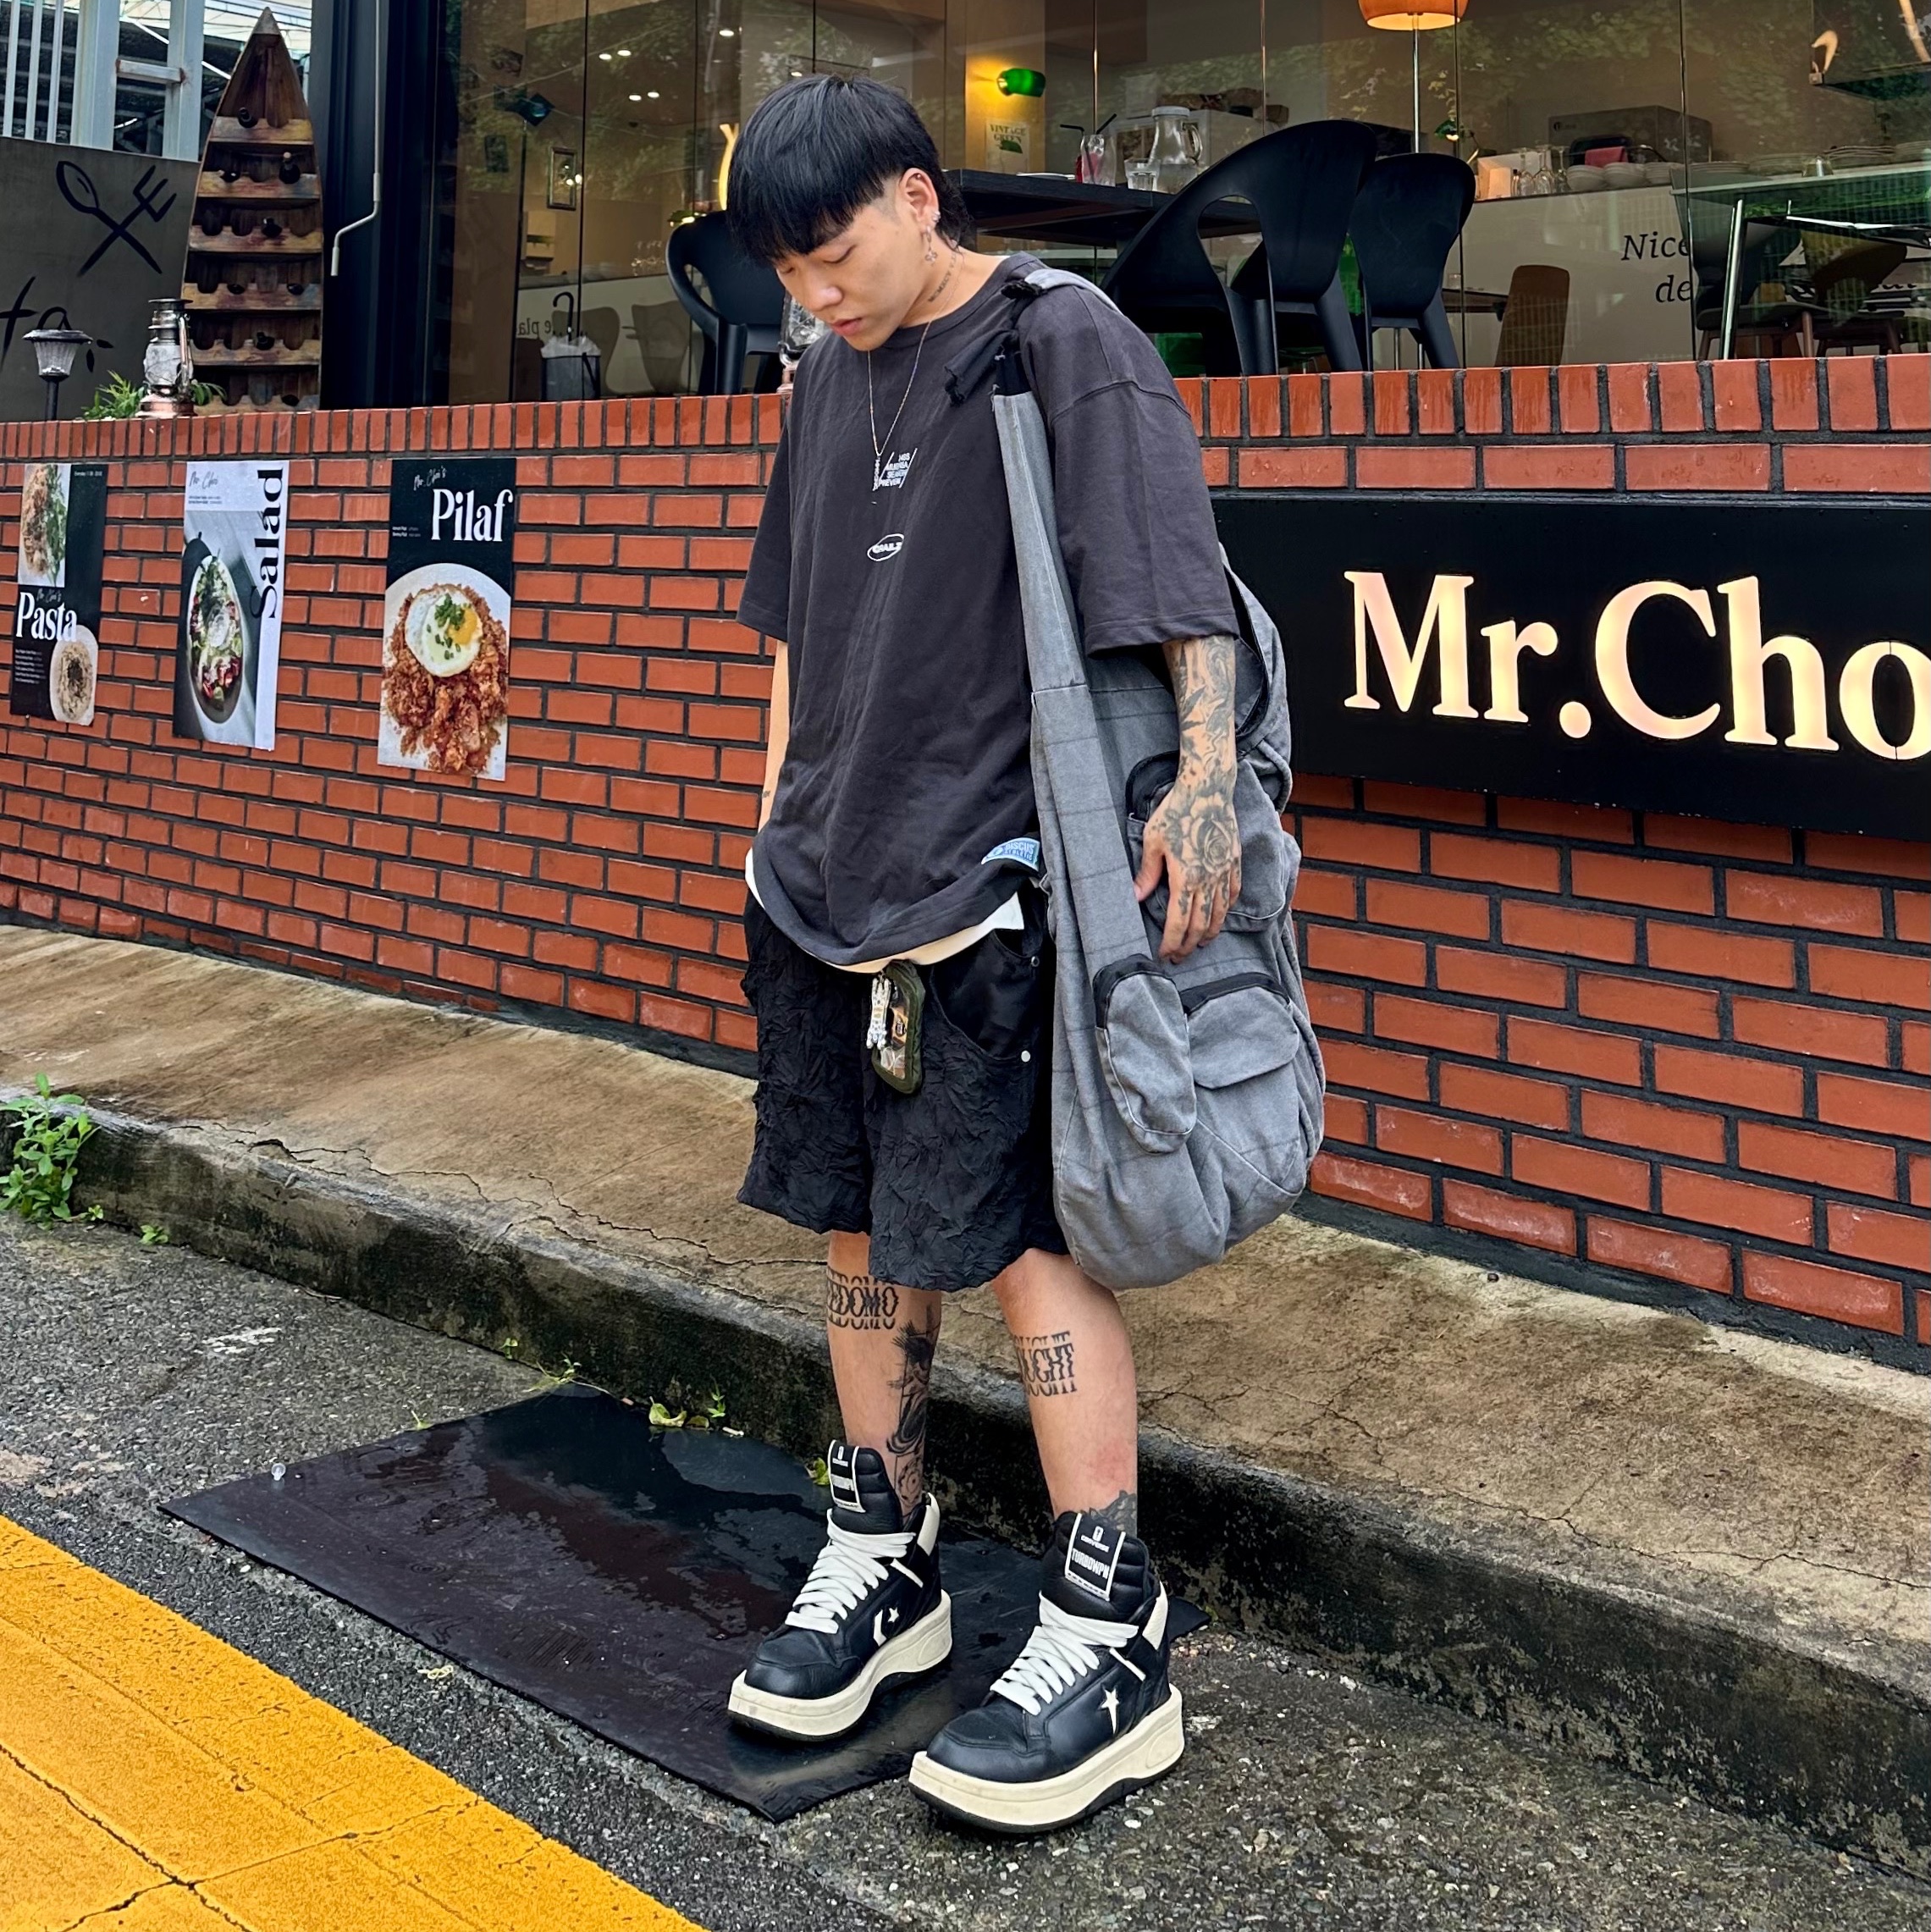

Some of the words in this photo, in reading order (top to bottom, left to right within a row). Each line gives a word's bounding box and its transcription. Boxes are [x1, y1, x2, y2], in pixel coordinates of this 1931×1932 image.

[251, 466, 284, 619] Salad
[431, 488, 514, 543] Pilaf
[15, 591, 78, 643] Pasta
